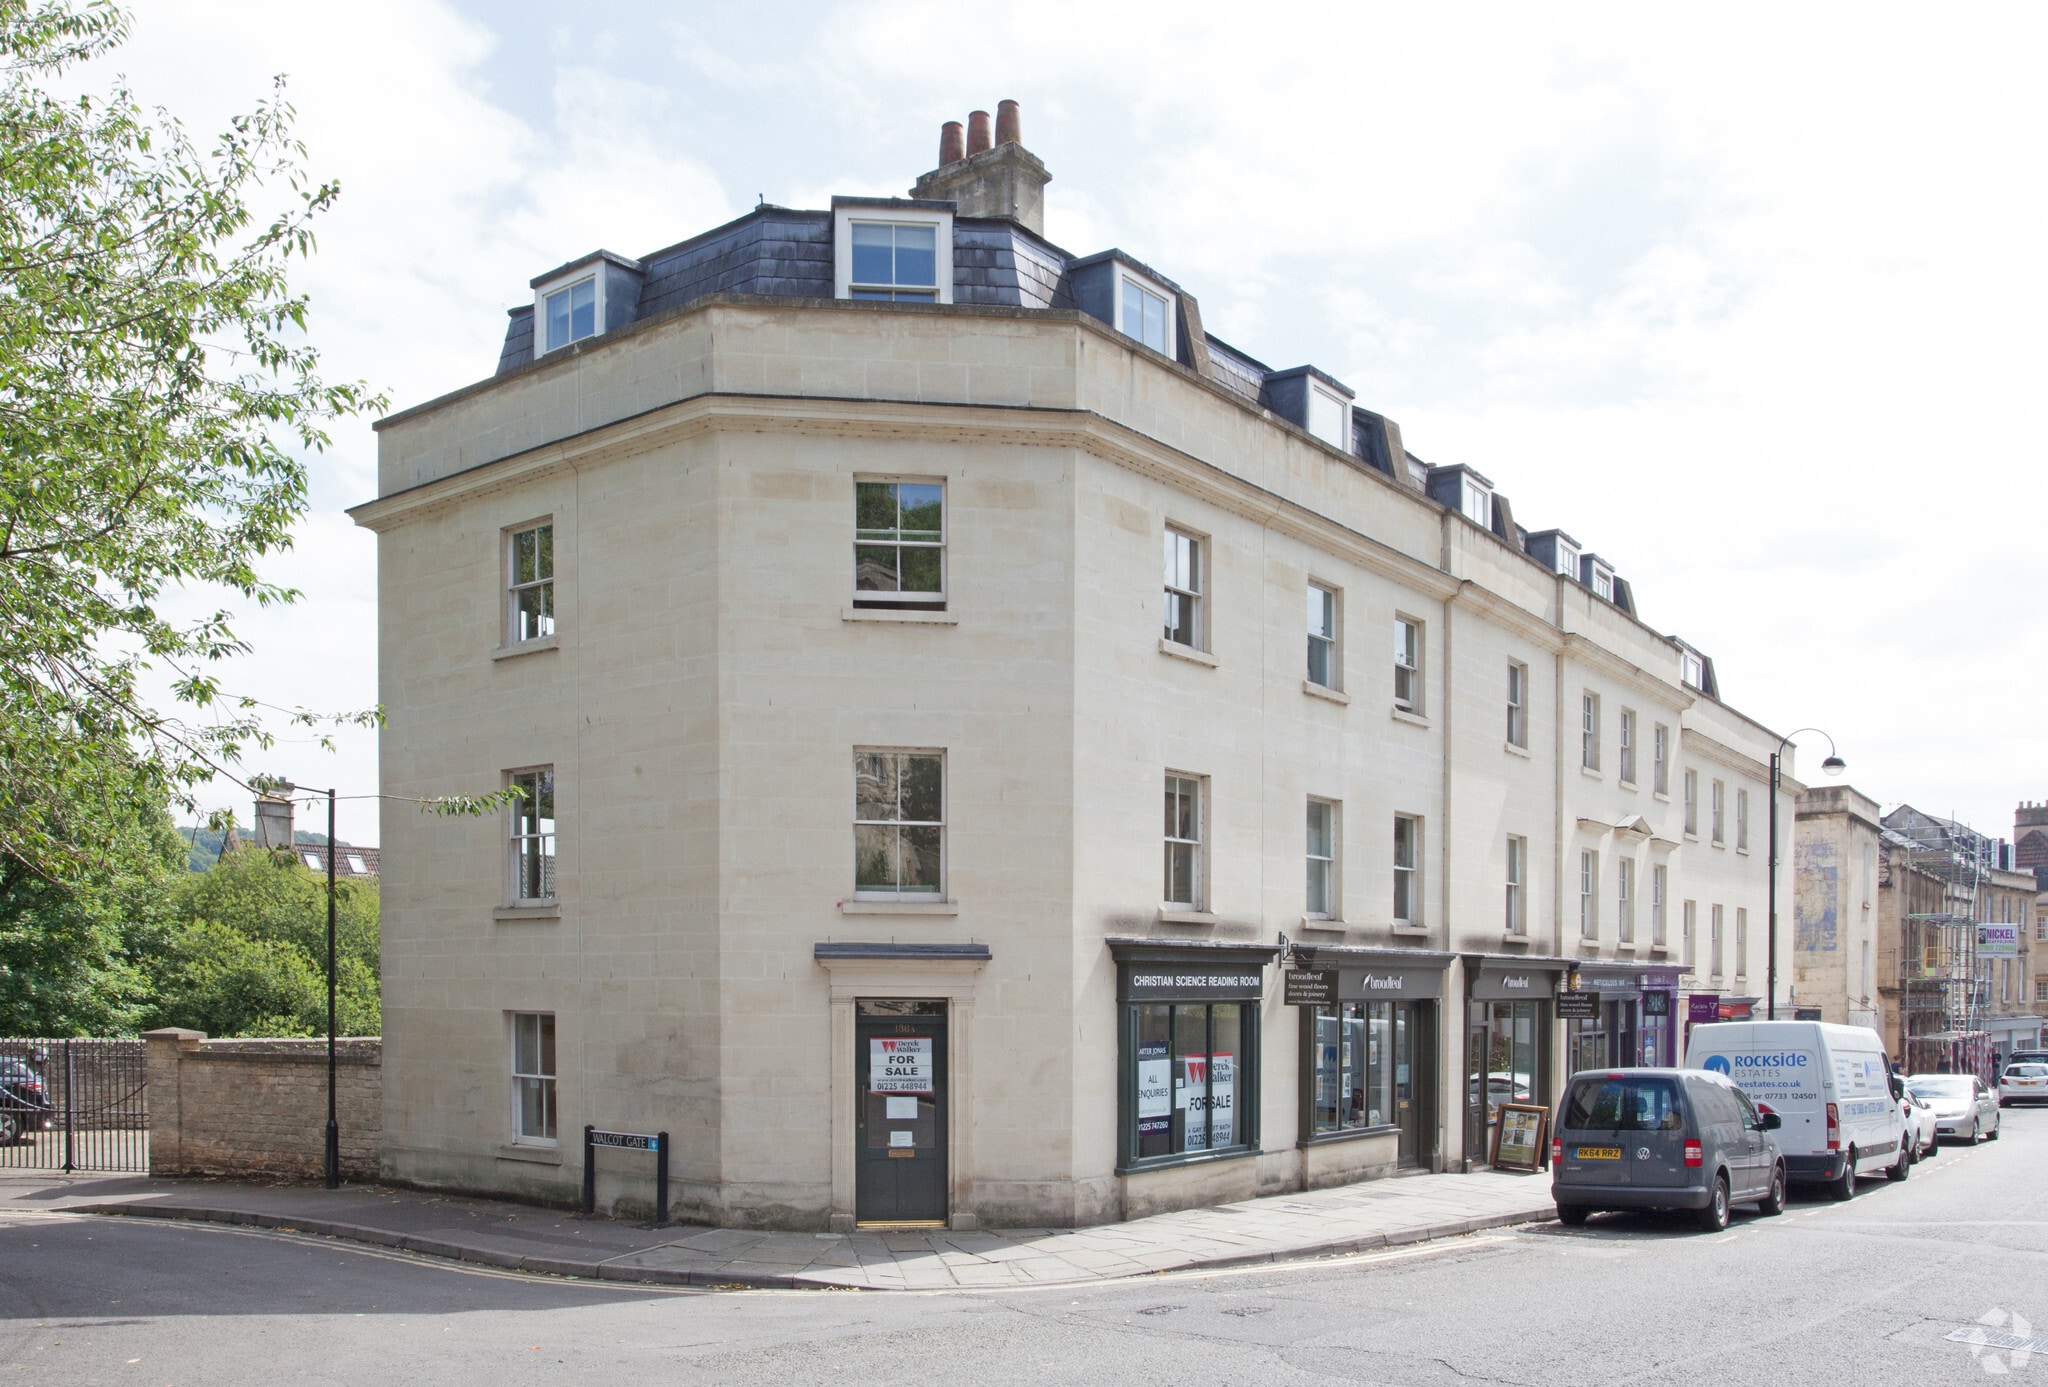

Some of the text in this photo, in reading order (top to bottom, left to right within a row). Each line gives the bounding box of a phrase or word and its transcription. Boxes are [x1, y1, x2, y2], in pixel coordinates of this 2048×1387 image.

[1986, 928, 2015, 939] NICKEL
[1133, 975, 1260, 987] CHRISTIAN SCIENCE READING ROOM
[1288, 972, 1323, 981] broadleaf
[1370, 975, 1403, 990] broadleaf
[1593, 979, 1617, 987] METICULOUS
[1308, 991, 1326, 999] joinery
[1138, 1046, 1167, 1056] ARTER JONAS
[888, 1055, 915, 1065] FOR
[1213, 1059, 1230, 1071] erek
[885, 1067, 919, 1076] SALE
[1734, 1069, 1780, 1078] ESTATES
[1147, 1075, 1158, 1084] ALL
[1212, 1071, 1232, 1083] alker
[877, 1082, 927, 1090] 01225 448944
[1736, 1080, 1802, 1088] eestates.co.uk
[1189, 1097, 1207, 1111] FOR
[1151, 1121, 1168, 1130] 747260
[592, 1132, 646, 1148] WALCOT GATE
[1187, 1131, 1230, 1146] 01225 48944
[1578, 1148, 1619, 1158] RK64 RRZ
